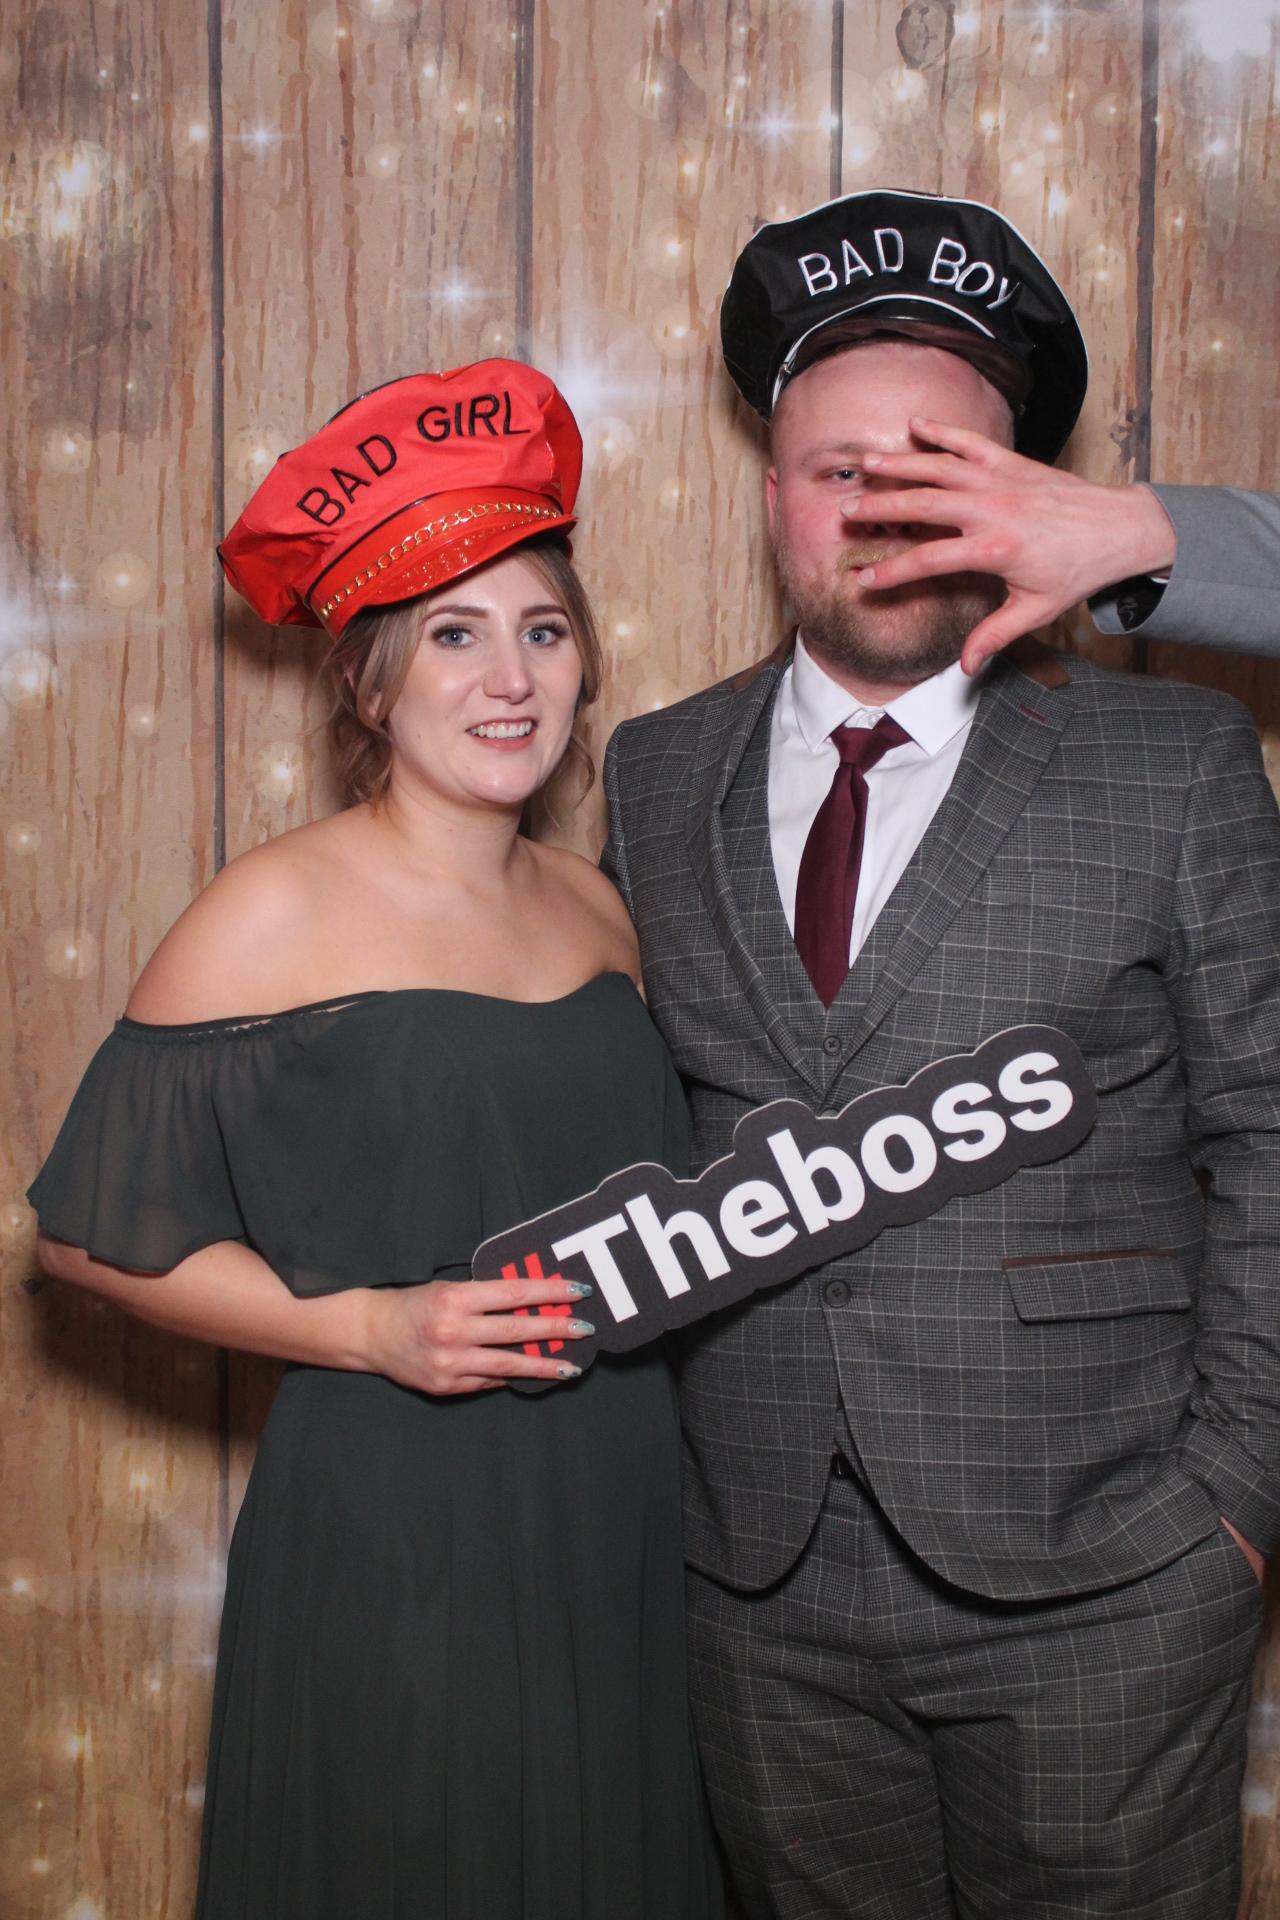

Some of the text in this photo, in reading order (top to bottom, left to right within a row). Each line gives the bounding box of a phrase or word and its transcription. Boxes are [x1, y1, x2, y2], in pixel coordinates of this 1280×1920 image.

[798, 228, 1020, 310] BAD BOY
[297, 391, 530, 527] BAD GIRL
